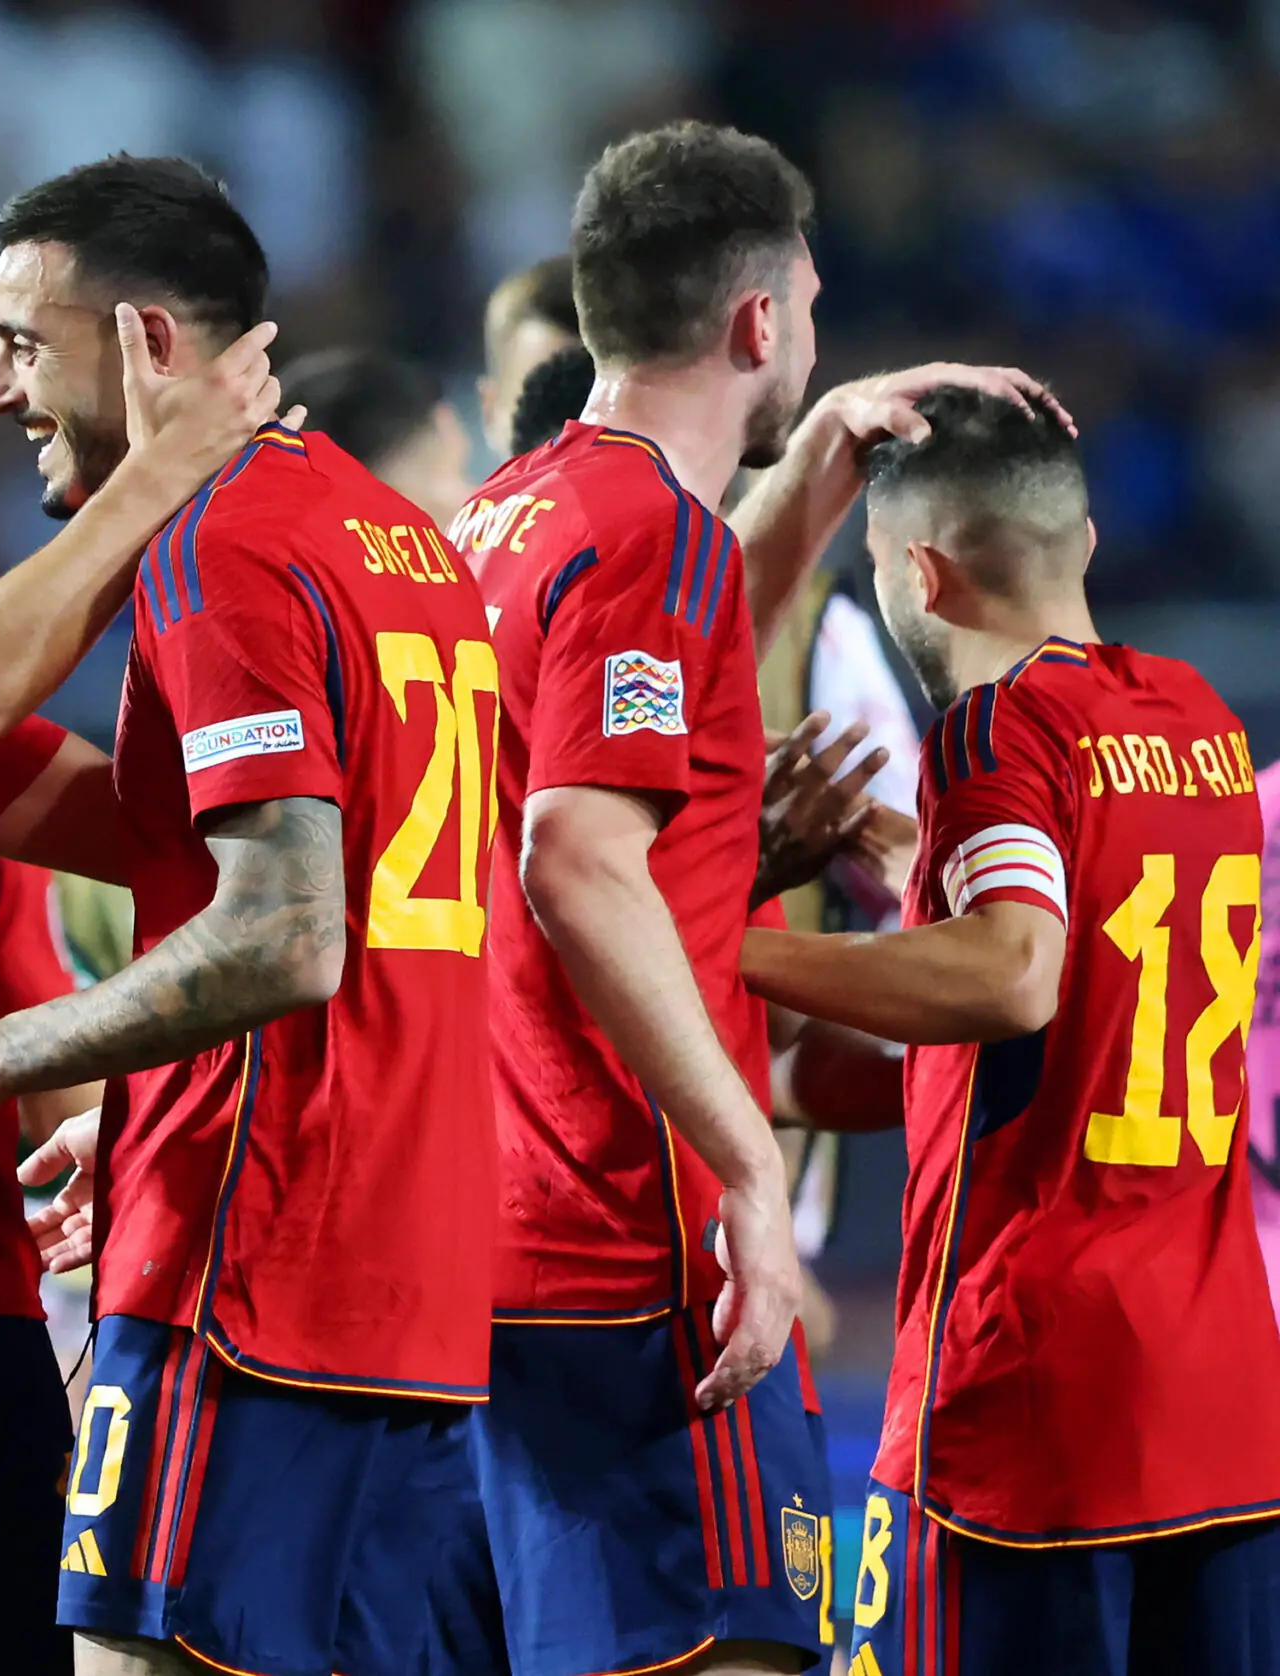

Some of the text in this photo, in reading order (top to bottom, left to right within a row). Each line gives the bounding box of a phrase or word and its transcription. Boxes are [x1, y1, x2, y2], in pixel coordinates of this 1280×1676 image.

[186, 722, 299, 759] FOUNDATION
[366, 632, 502, 958] 20
[1084, 854, 1263, 1167] 18
